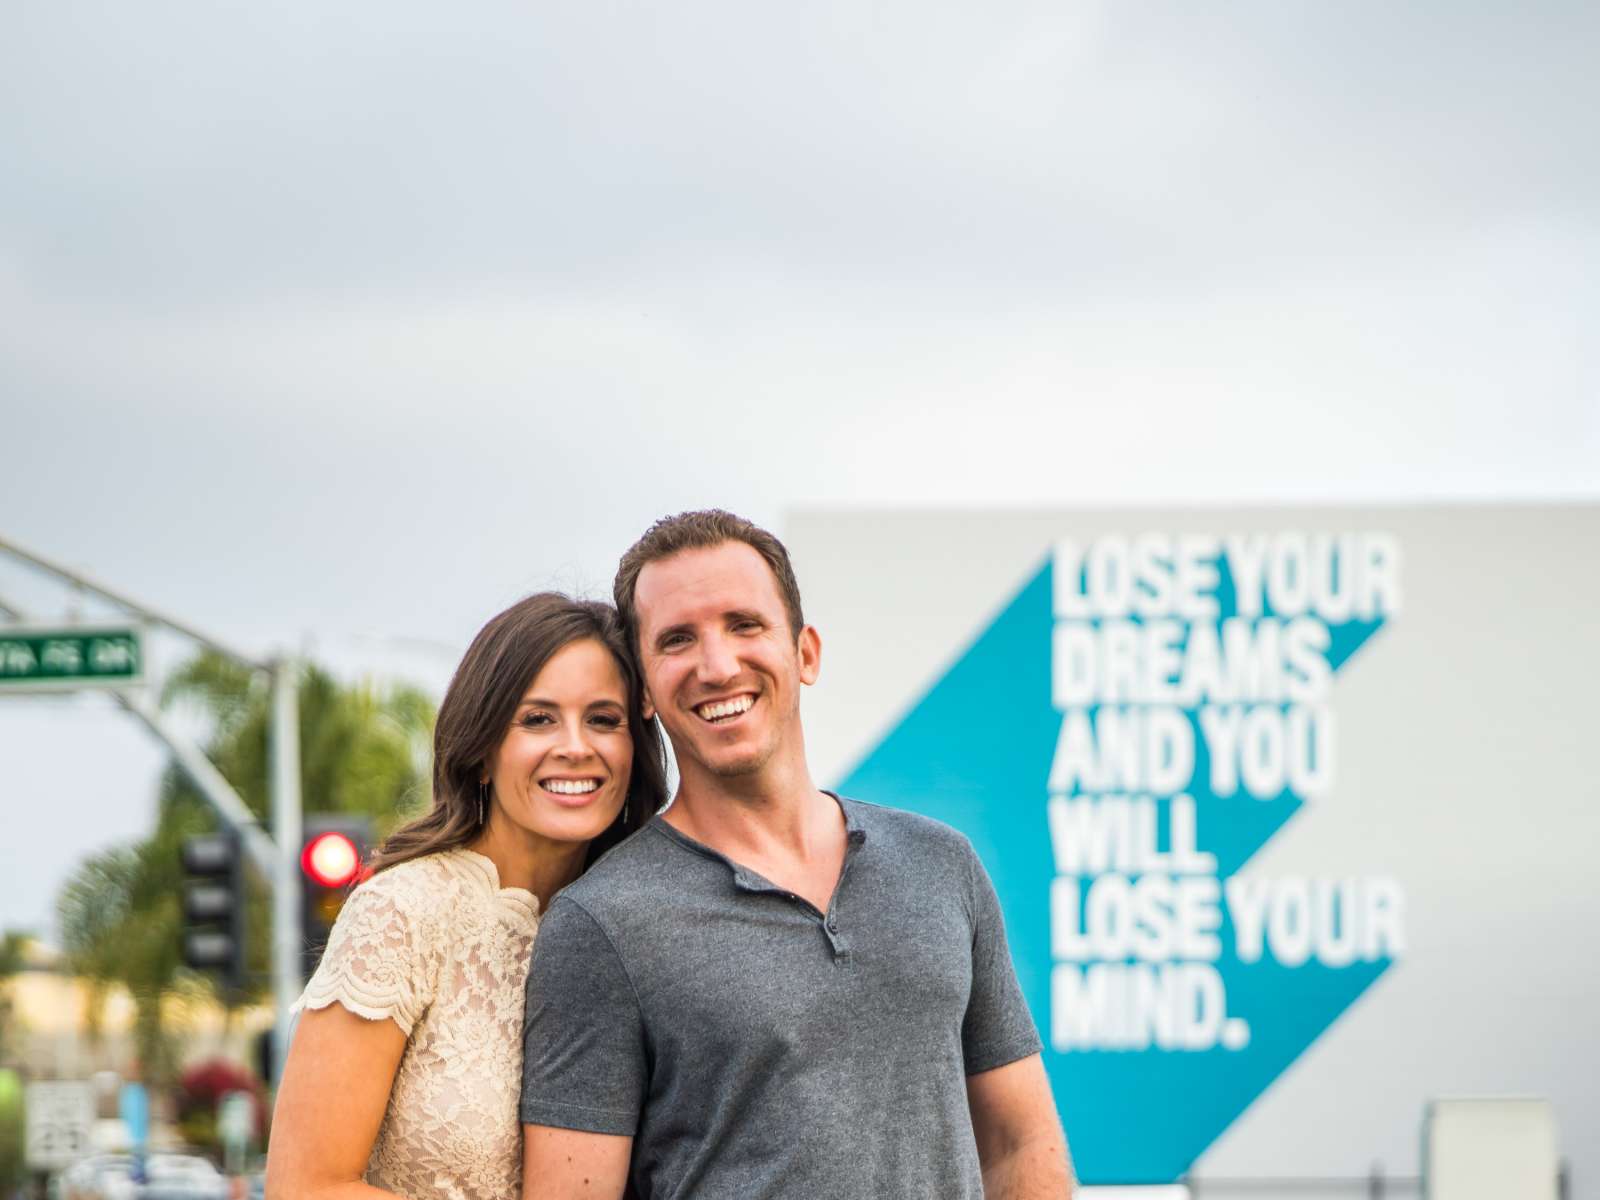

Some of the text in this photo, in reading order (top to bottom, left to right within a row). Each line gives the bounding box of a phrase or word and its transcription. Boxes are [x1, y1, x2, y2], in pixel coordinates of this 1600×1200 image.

[1052, 533, 1401, 624] LOSE YOUR
[1051, 617, 1333, 708] DREAMS
[1047, 704, 1336, 799] AND YOU
[1047, 794, 1218, 877] WILL
[1050, 873, 1403, 967] LOSE YOUR
[1050, 961, 1251, 1052] MIND.
